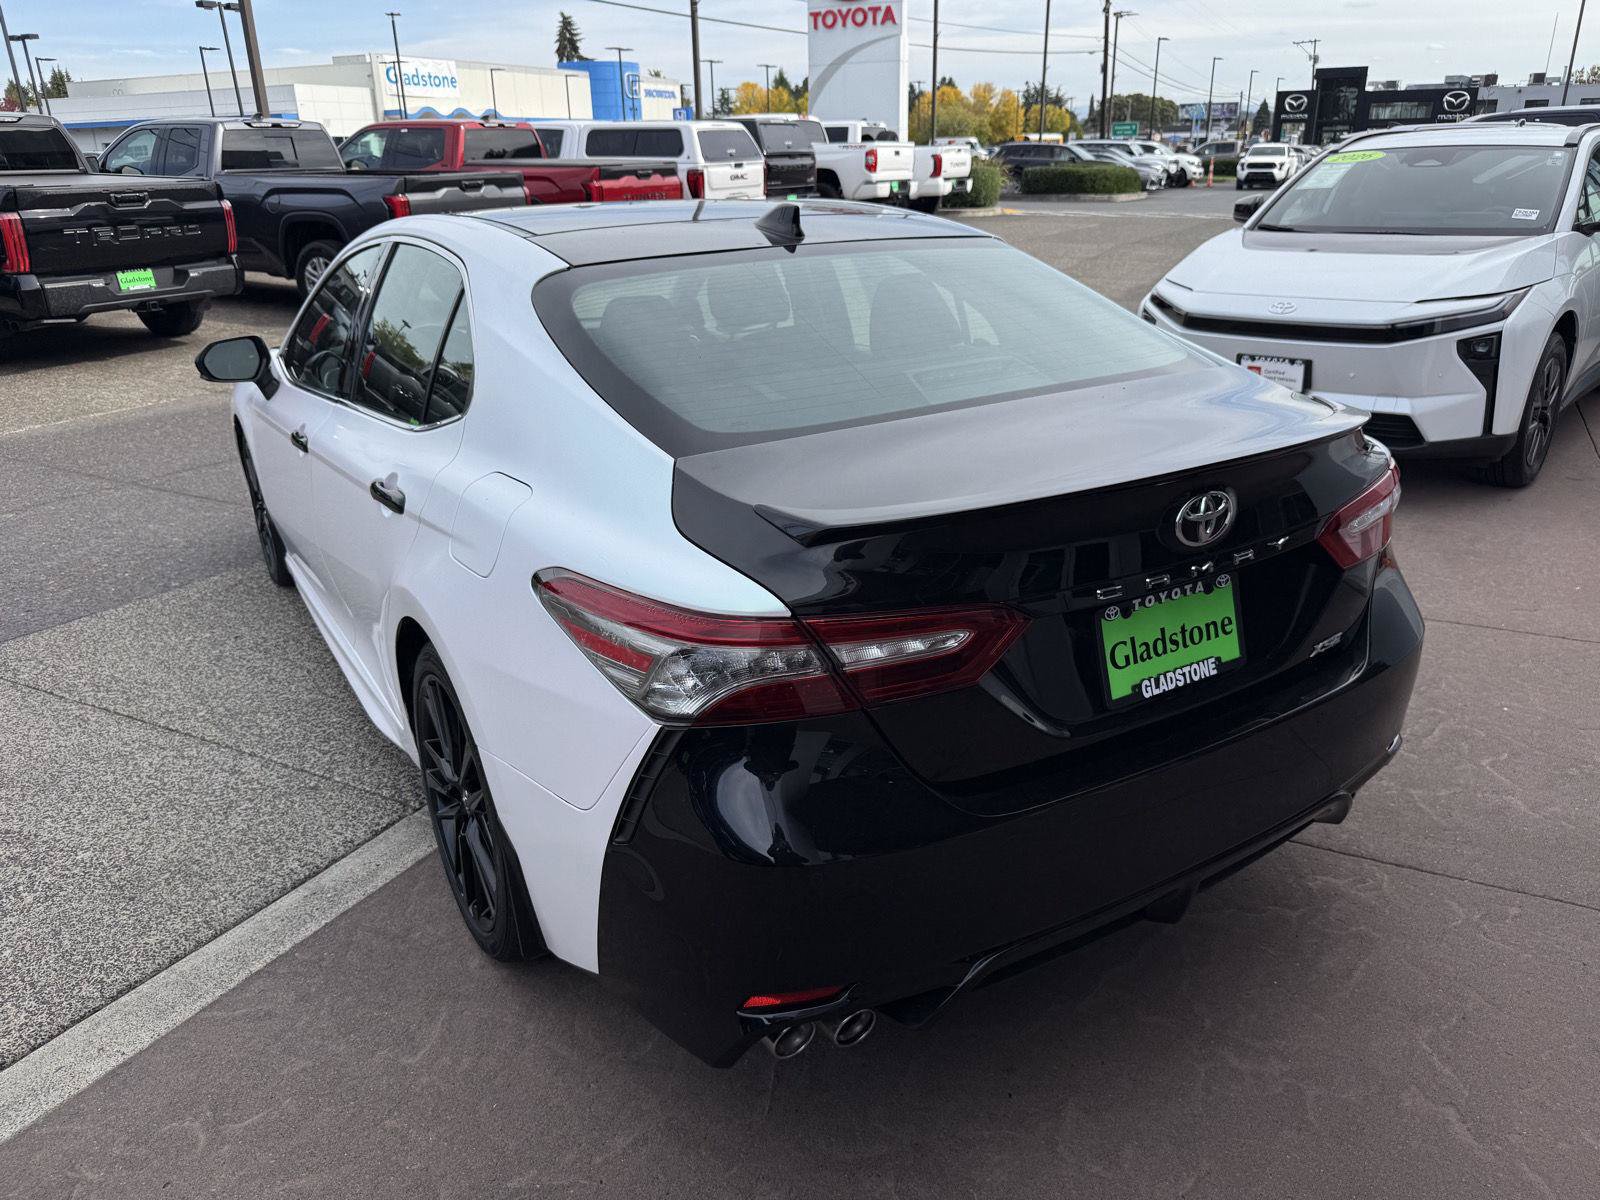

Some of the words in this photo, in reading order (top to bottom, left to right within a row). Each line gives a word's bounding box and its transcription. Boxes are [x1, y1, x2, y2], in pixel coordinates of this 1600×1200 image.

[809, 5, 897, 31] TOYOTA
[385, 65, 458, 88] Gadstone
[729, 173, 749, 181] GMC
[120, 275, 153, 285] Gladstone
[1096, 535, 1290, 600] CAMRY
[1132, 581, 1205, 611] TOYOTA
[1109, 615, 1234, 670] Gladstone
[1141, 656, 1218, 699] GLADSTONE
